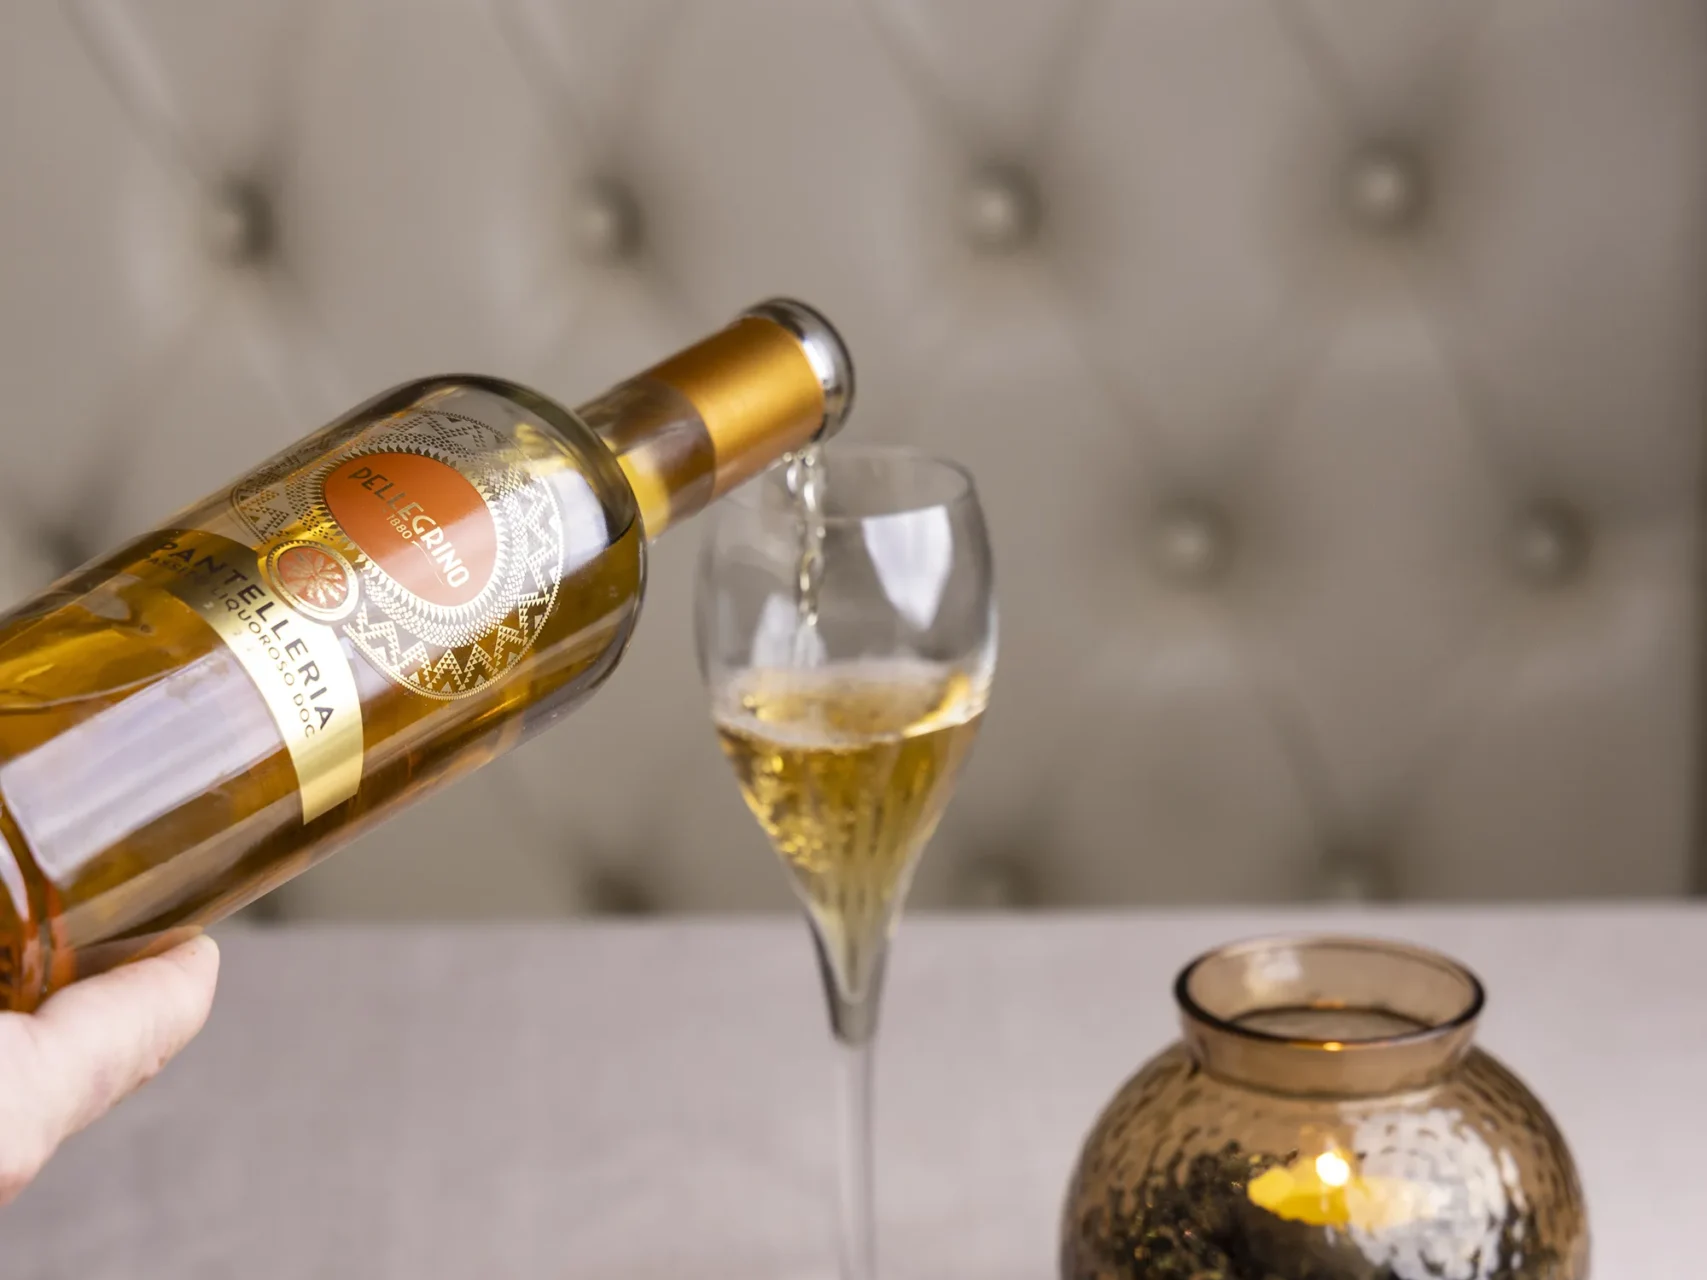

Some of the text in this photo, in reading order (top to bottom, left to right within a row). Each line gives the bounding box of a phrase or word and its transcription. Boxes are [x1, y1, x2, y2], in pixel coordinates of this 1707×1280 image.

[347, 466, 470, 588] PELLEGRINO
[386, 513, 413, 539] 1880
[154, 542, 335, 731] PANTELLERIA
[211, 586, 296, 687] LIQUOROSO
[293, 692, 316, 738] DOC
